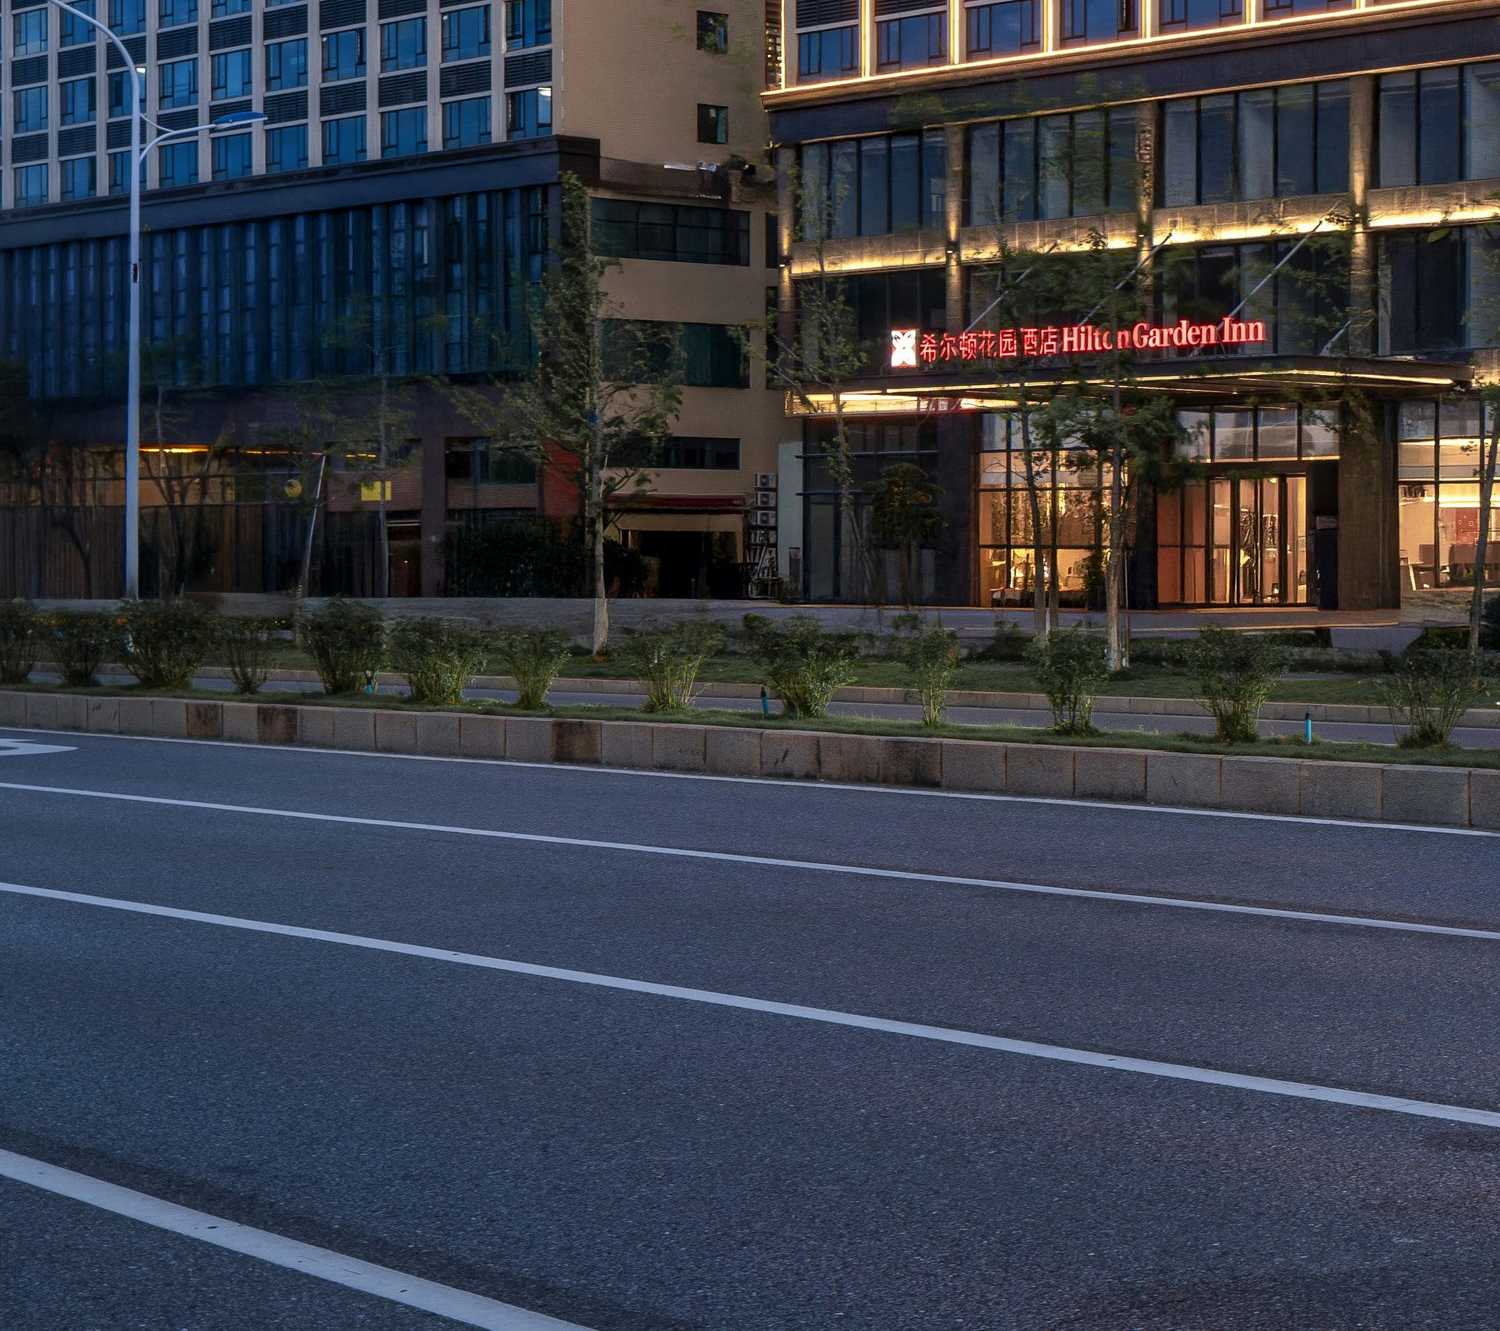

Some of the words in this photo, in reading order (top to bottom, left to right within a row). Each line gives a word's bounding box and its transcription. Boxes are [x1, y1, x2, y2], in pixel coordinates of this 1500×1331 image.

[920, 326, 1058, 363] 希尔顿花园酒店
[1132, 319, 1218, 349] Garden
[1221, 316, 1267, 343] Inn
